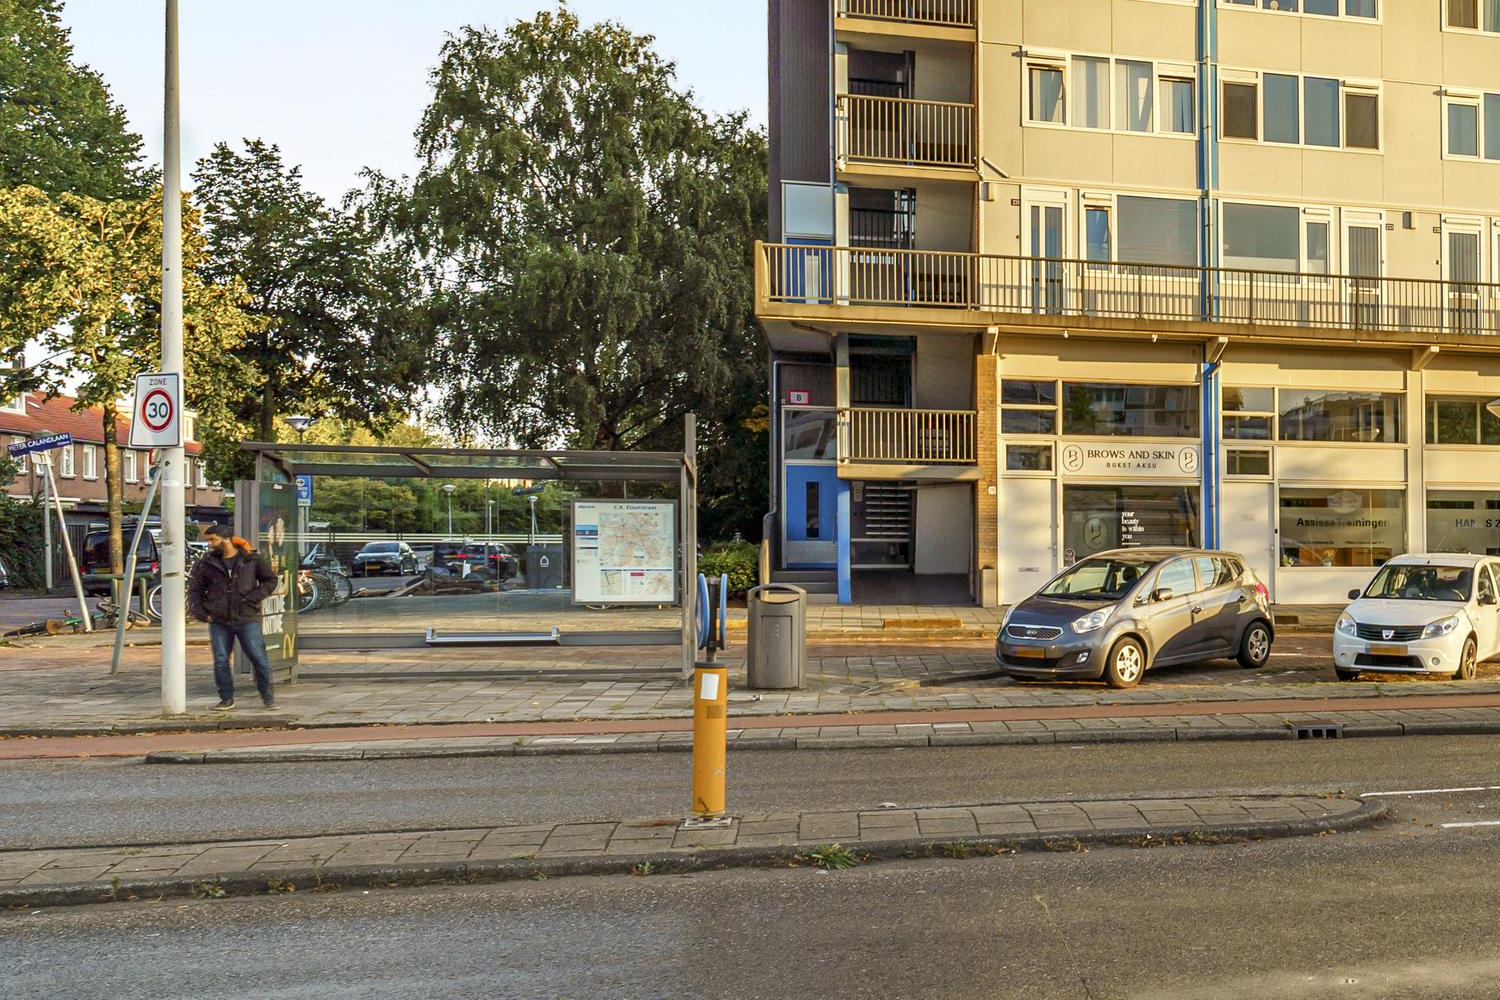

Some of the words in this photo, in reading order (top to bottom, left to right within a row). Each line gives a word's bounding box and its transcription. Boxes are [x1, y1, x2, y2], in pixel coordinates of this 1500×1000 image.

[149, 378, 167, 386] ZONE
[148, 402, 169, 419] 30
[27, 433, 69, 447] CALANDLAAN
[1087, 450, 1126, 459] BROWS
[1128, 450, 1150, 459] AND
[1152, 451, 1175, 460] SKIN
[1121, 511, 1135, 519] your
